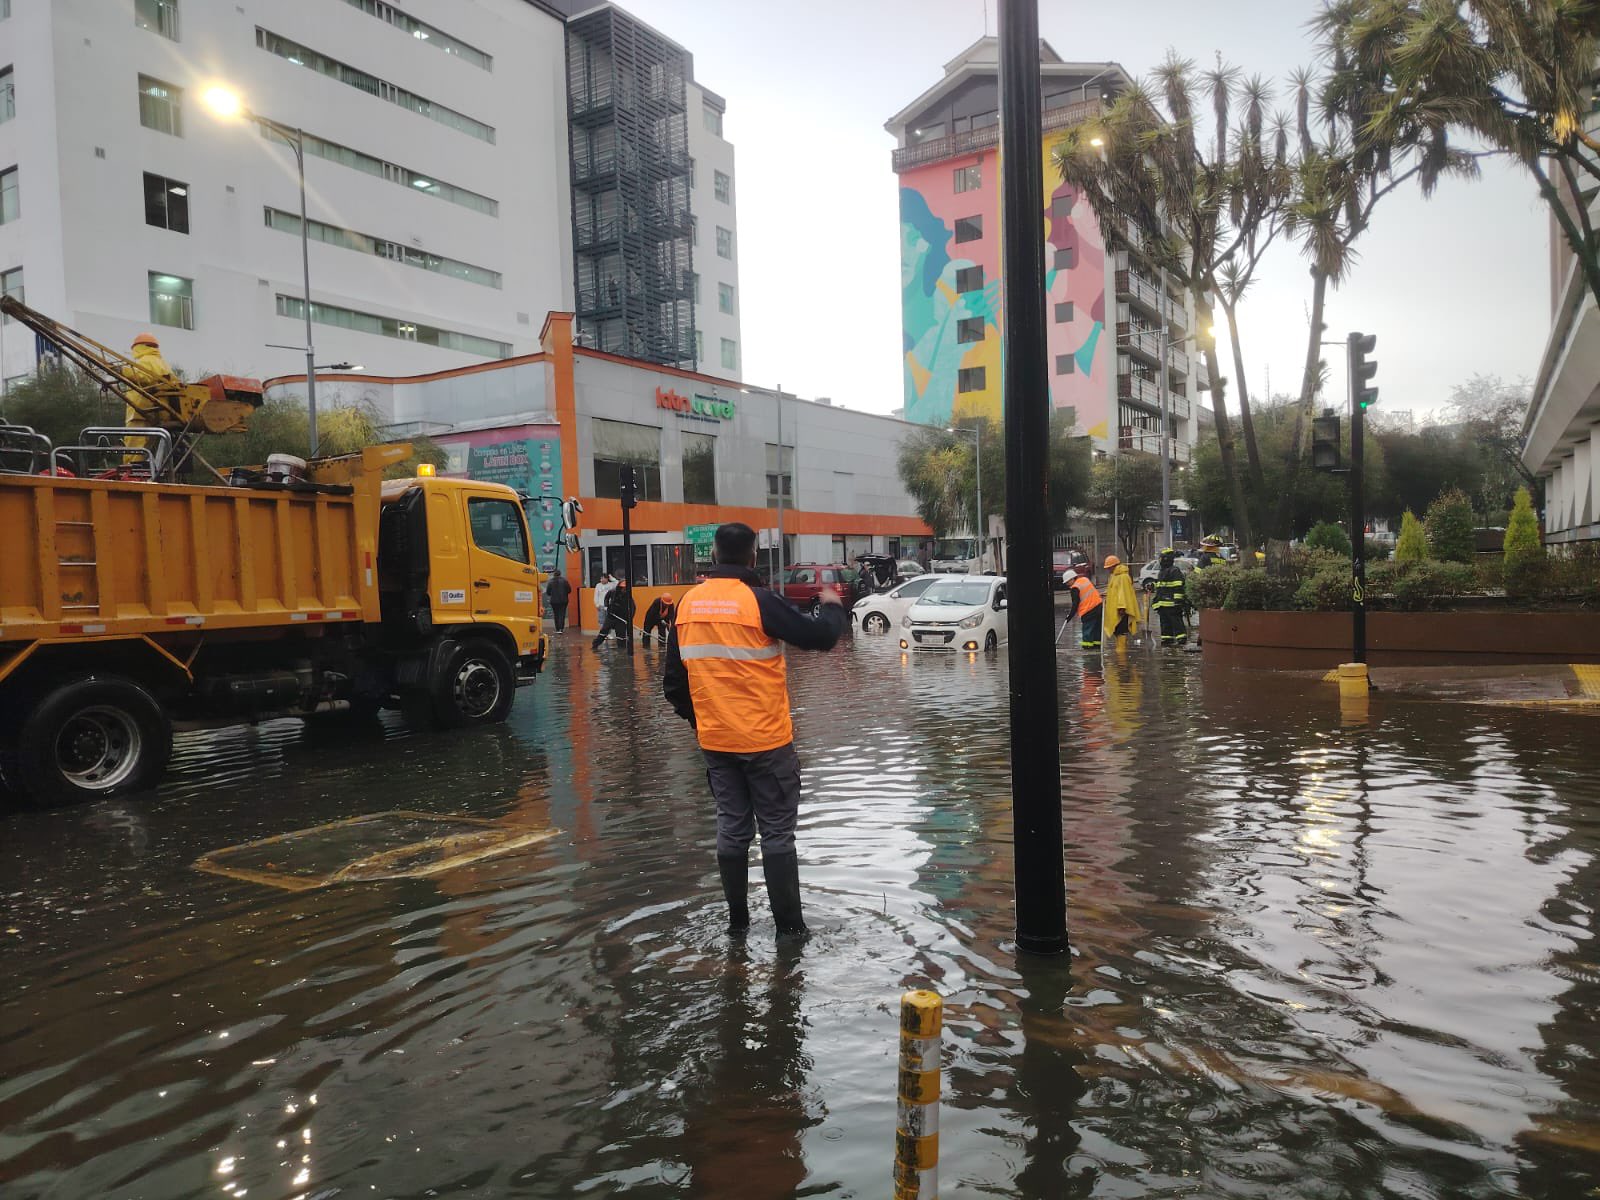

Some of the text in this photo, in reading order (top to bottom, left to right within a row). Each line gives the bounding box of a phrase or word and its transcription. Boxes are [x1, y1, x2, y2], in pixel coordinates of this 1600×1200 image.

[655, 386, 691, 412] latin
[484, 455, 528, 467] LATIN BOX
